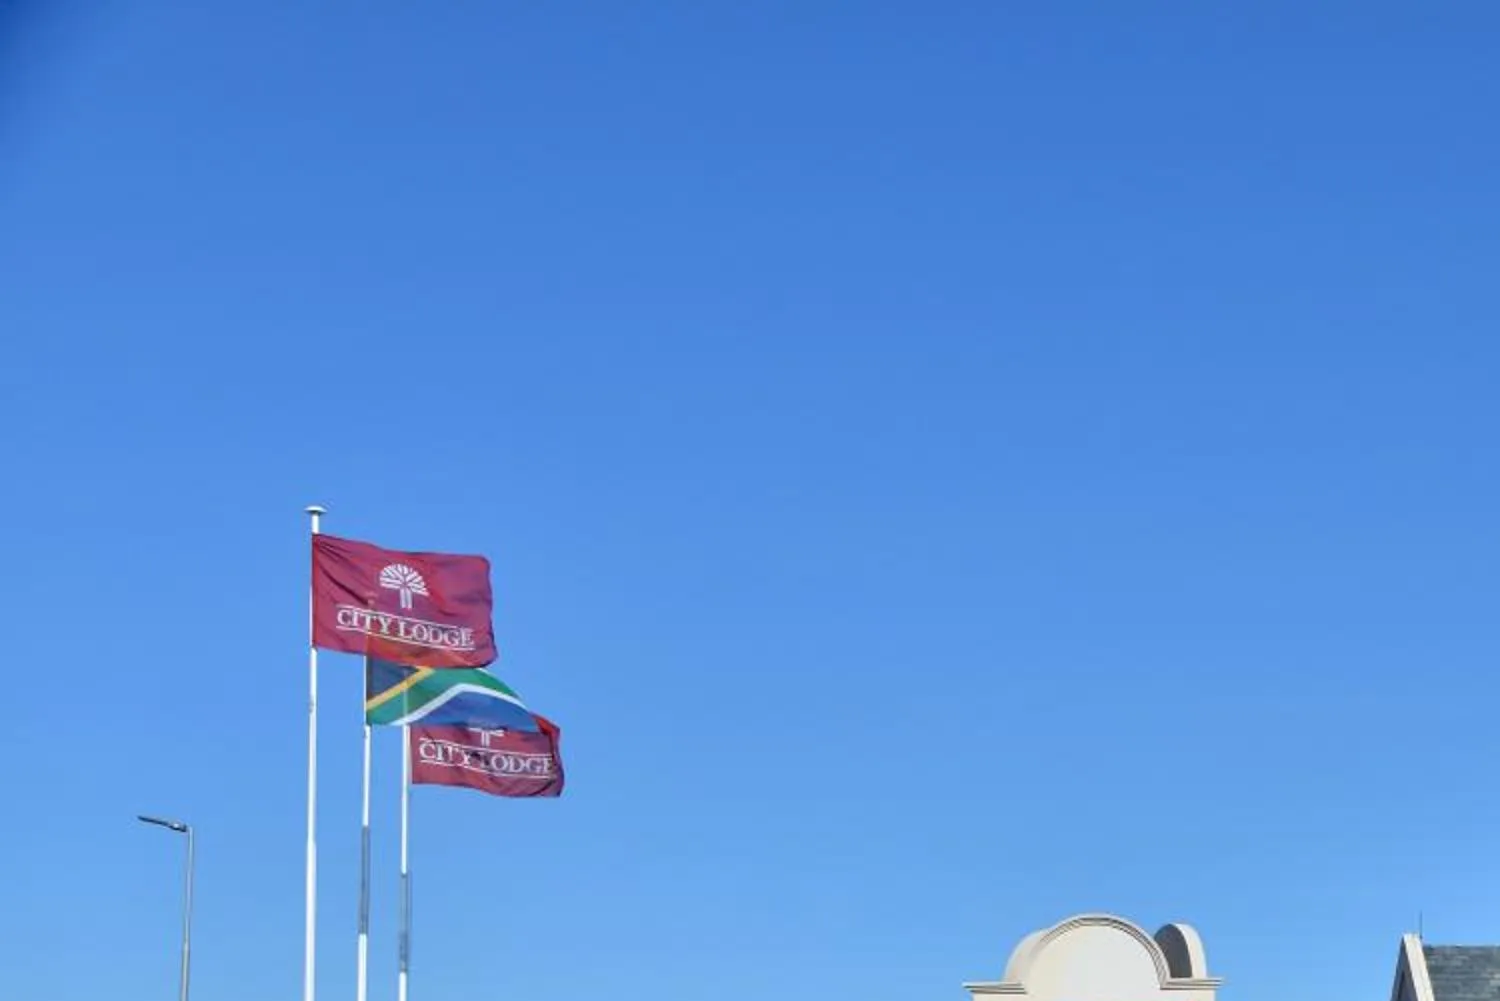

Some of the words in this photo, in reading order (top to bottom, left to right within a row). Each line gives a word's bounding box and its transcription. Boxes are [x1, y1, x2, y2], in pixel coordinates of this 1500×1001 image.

[337, 609, 392, 635] CITY
[398, 620, 475, 647] LODGE
[419, 742, 472, 766] CITY
